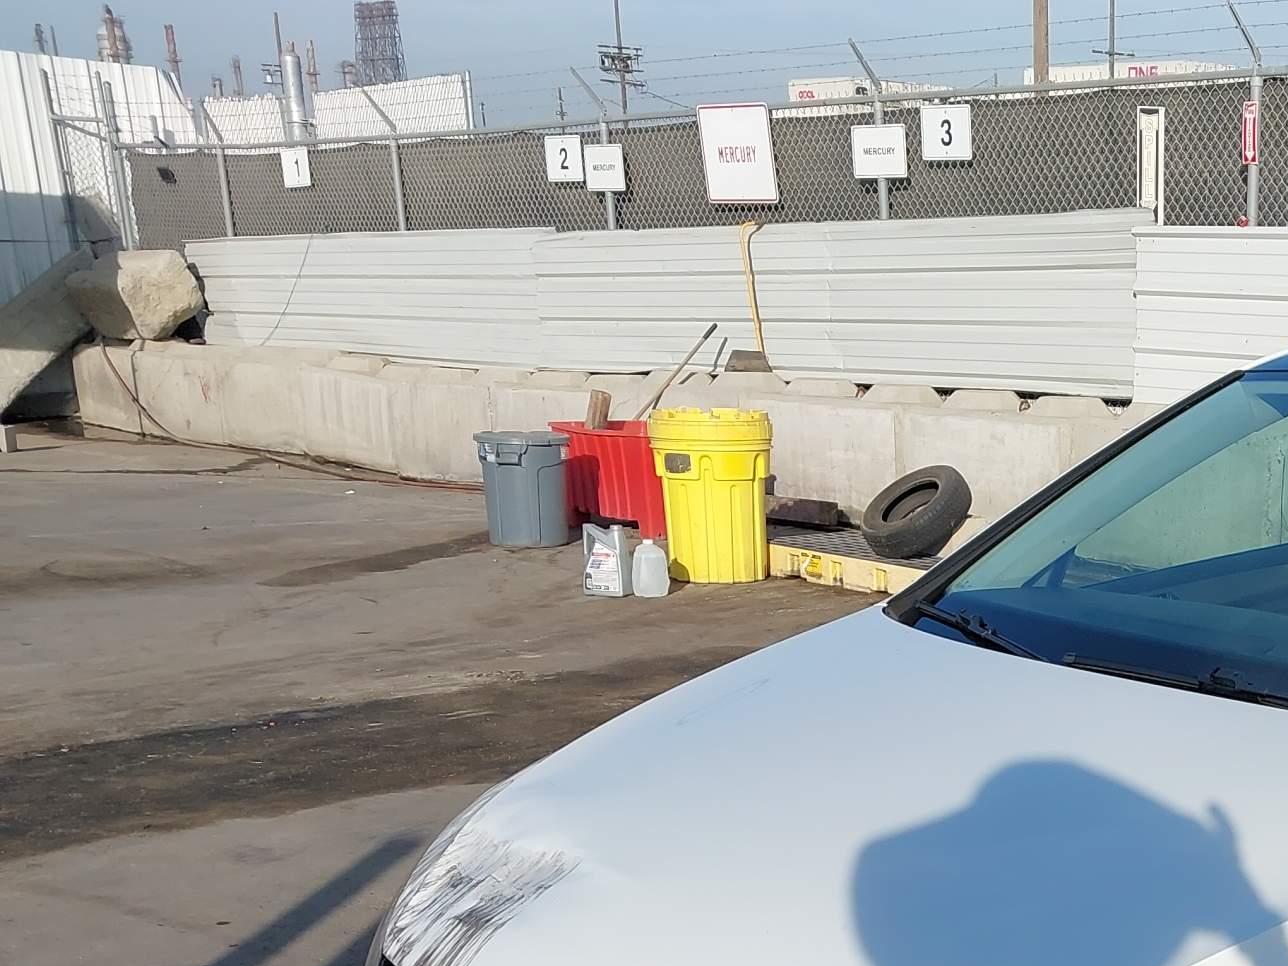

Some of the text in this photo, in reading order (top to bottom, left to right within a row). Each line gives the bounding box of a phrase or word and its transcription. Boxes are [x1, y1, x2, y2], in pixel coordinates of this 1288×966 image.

[940, 119, 953, 147] 3
[559, 147, 569, 170] 2
[717, 145, 757, 164] MERCURY
[862, 146, 896, 156] MERCURY
[1144, 117, 1154, 199] SPILL
[294, 157, 301, 177] 1
[592, 163, 616, 172] MERCURY
